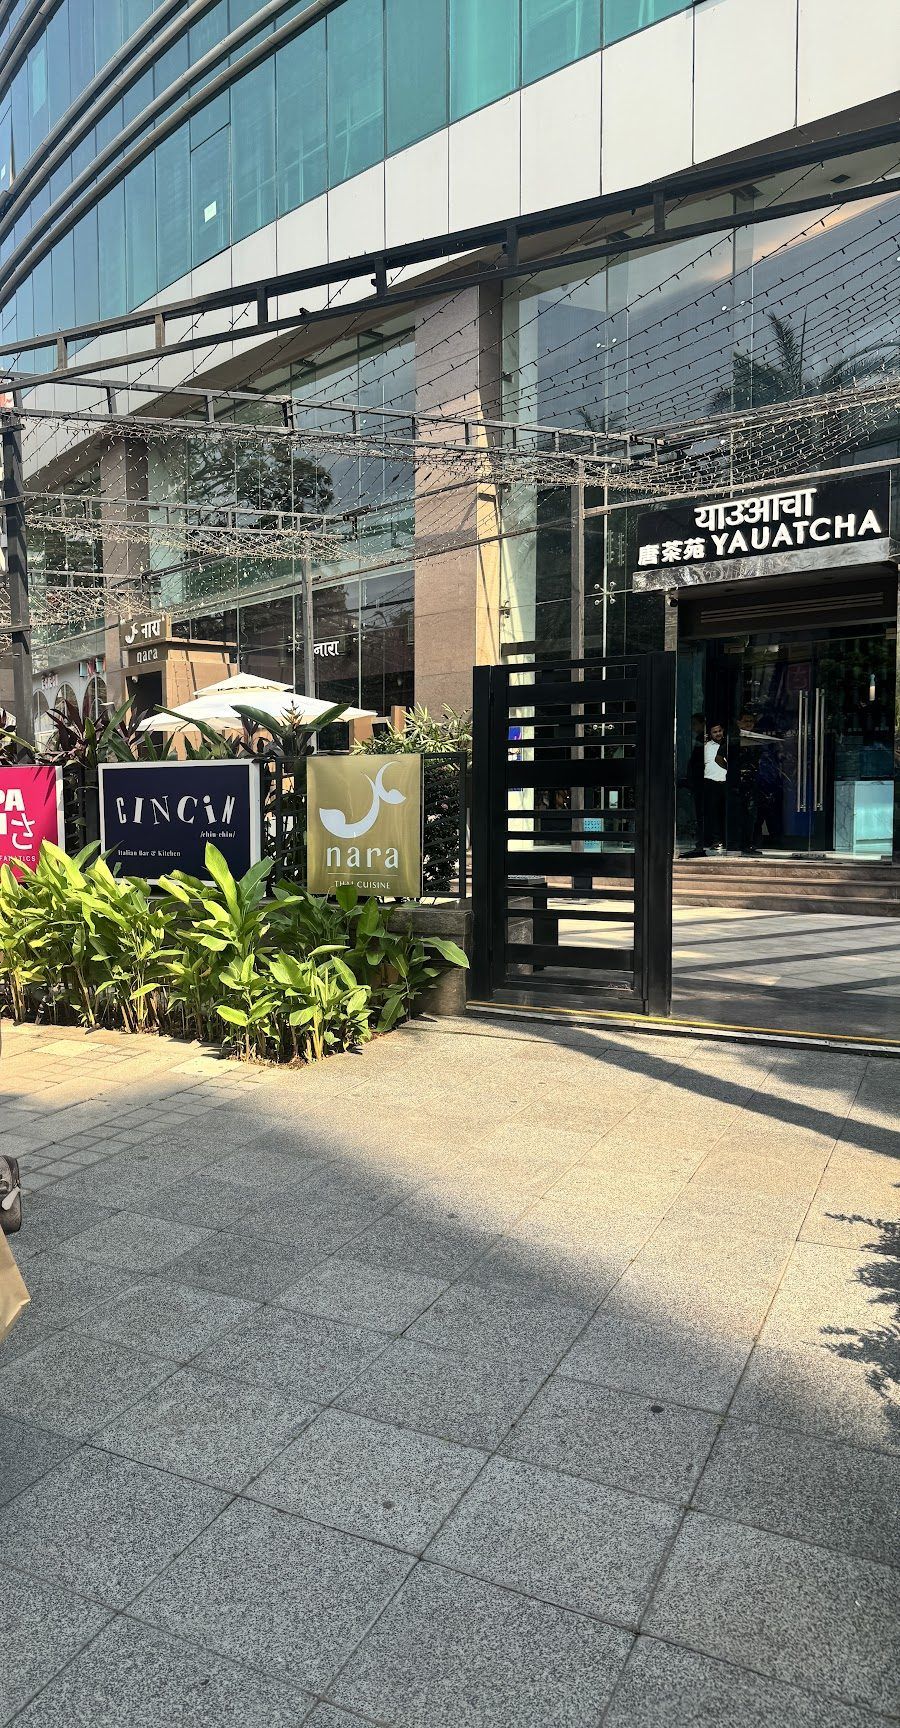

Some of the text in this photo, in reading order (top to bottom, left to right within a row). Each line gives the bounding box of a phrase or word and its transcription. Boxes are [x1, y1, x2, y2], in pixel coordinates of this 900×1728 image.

[693, 488, 817, 532] याउआचा
[637, 509, 883, 566] 唐茶苑 YAUATCHA
[136, 648, 158, 664] nara
[0, 788, 26, 811] A
[326, 846, 399, 869] nara
[356, 881, 391, 890] CUISINE
